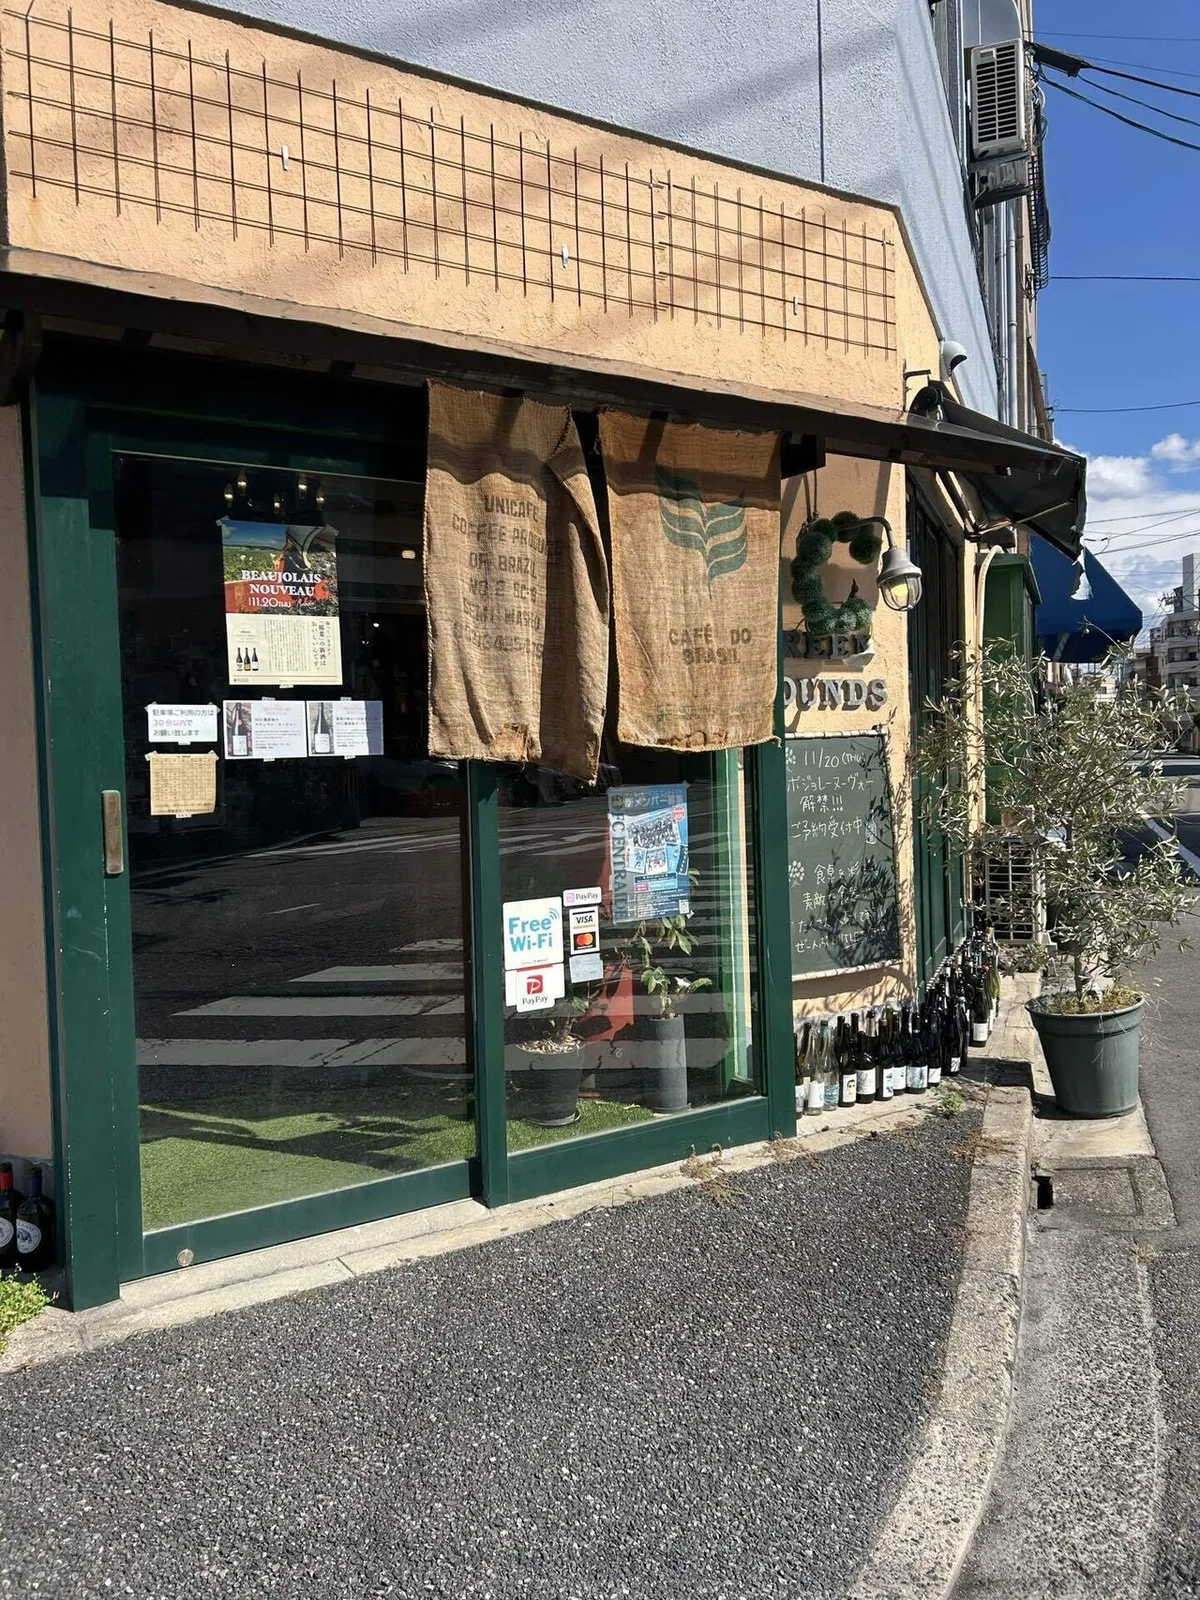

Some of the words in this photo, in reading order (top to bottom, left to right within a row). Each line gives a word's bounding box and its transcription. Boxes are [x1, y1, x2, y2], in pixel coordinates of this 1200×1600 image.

[469, 551, 490, 571] OF
[498, 554, 538, 580] BRAZIL
[241, 570, 322, 584] BEAUJOLAIS
[249, 583, 315, 596] NOUVEAU
[730, 627, 752, 645] DO
[152, 708, 214, 717] 駐車場ご利用の方は
[804, 747, 840, 769] 11/20
[787, 772, 875, 793] ボジョレーヌーヴォー
[576, 891, 599, 902] PayPay
[508, 916, 552, 935] Free
[575, 915, 594, 924] VISA
[510, 932, 553, 953] Wi-Fi
[522, 995, 549, 1006] PayPay
